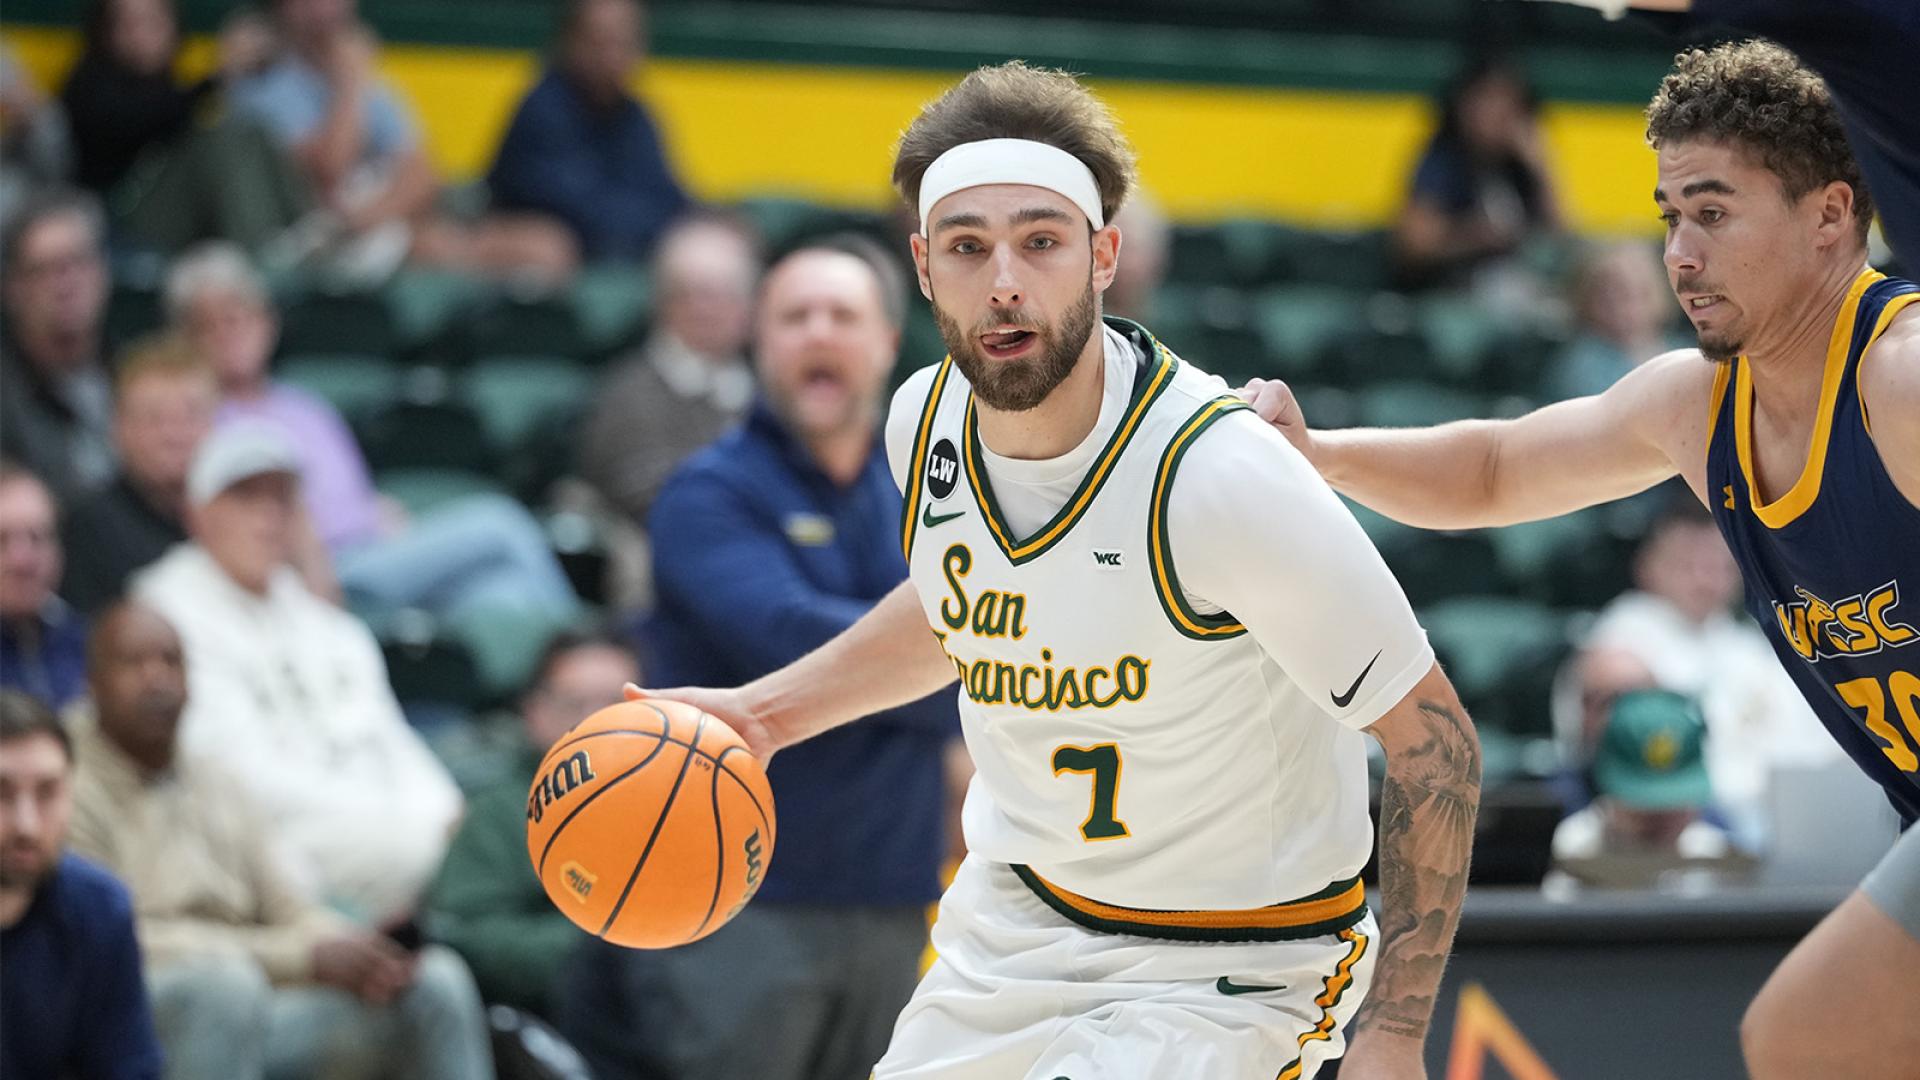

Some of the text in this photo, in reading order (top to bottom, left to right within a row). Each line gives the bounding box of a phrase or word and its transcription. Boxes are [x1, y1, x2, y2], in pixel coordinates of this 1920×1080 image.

[929, 453, 957, 484] LW
[941, 542, 1028, 640] San
[1092, 551, 1122, 566] WCC
[930, 627, 1151, 711] rancisco
[1051, 742, 1131, 842] 7
